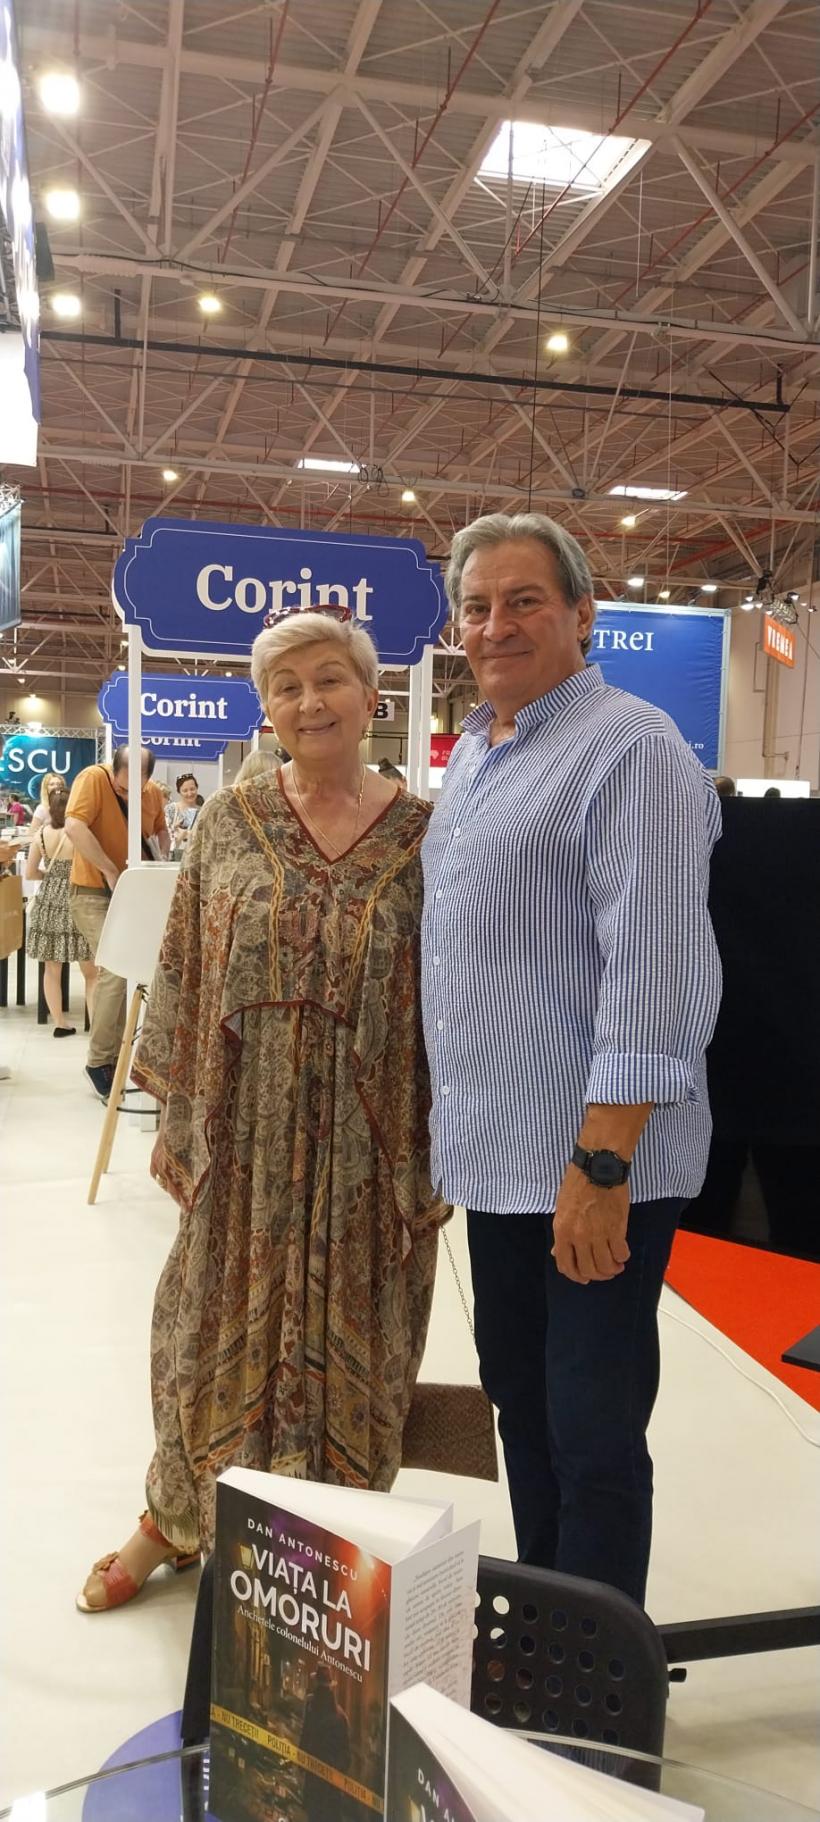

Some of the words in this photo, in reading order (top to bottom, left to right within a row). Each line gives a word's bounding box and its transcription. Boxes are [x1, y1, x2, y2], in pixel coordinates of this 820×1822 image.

[196, 563, 374, 621] Corint
[140, 692, 228, 720] Corint
[247, 1518, 273, 1539] DAN
[279, 1533, 359, 1581] ANTONESCU
[252, 1544, 318, 1600] VIAȚA
[322, 1579, 353, 1620] LA
[230, 1569, 371, 1672] OMORURI
[237, 1604, 276, 1632] Anchetele
[276, 1625, 320, 1657] colonelului
[320, 1650, 363, 1684] Antonescu
[418, 1768, 440, 1808] DAN
